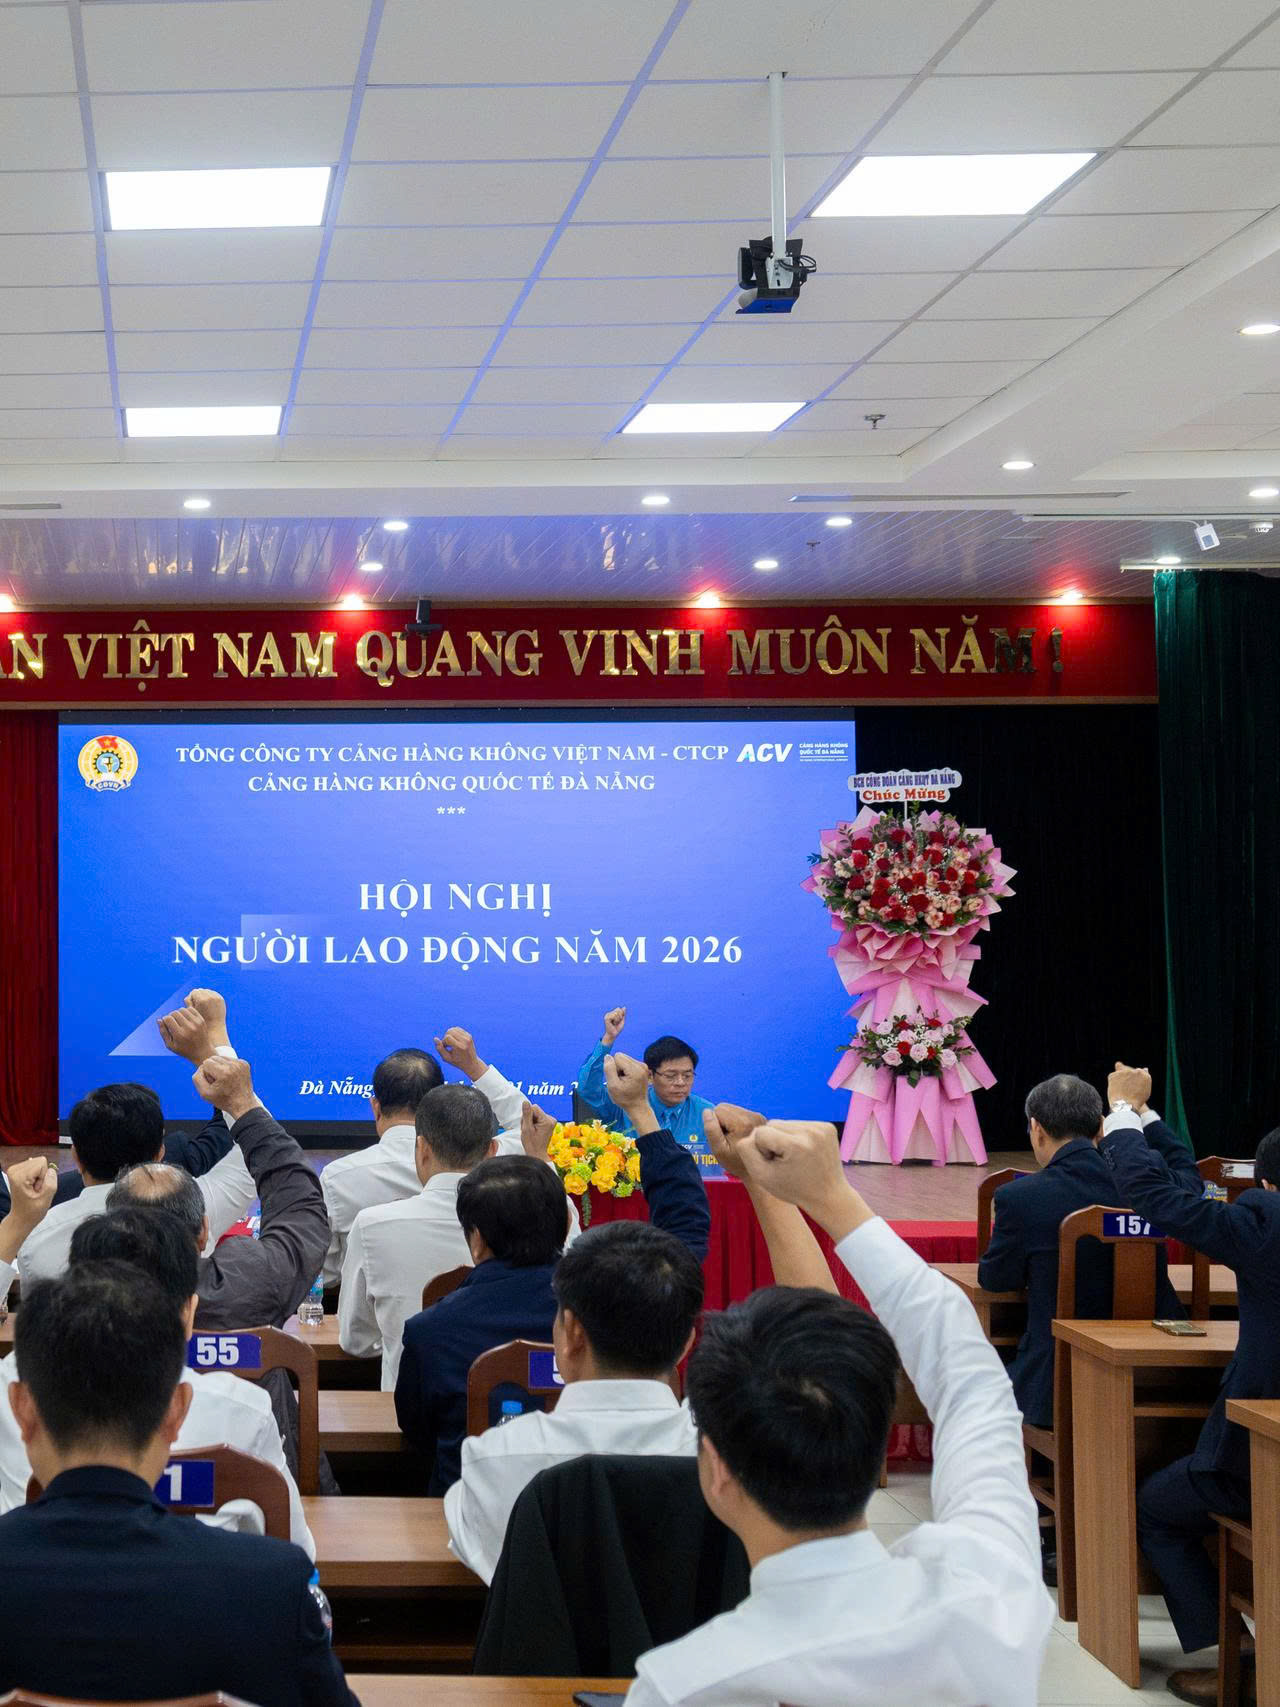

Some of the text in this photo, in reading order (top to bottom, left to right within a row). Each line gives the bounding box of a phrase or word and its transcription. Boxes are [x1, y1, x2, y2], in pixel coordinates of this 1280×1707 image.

[63, 619, 195, 692] VIỆT
[213, 631, 338, 678] NAM
[355, 628, 544, 688] QUANG
[558, 629, 705, 676] VINH
[726, 614, 892, 675] MUÔN
[909, 614, 1037, 675] NĂM
[176, 743, 235, 762] TỔNG
[240, 743, 300, 762] CÔNG
[305, 747, 334, 762] TY
[338, 743, 397, 762] CẢNG
[403, 743, 463, 762] HÀNG
[471, 742, 547, 761] KHÔNG
[552, 743, 602, 764] VIỆT
[607, 746, 655, 761] NAM
[672, 745, 729, 761] CTCP
[736, 743, 793, 762] ACV
[248, 771, 655, 794] CẢNG HÀNG KHÔNG QUỐC TẾ ĐÀ NẴNG
[863, 788, 946, 800] Chúc Mừng
[359, 878, 553, 918] HỘI NGHỊ
[171, 928, 743, 971] NGƯỜI LAO ĐỘNG NĂM 2026
[299, 1080, 325, 1095] Đà
[528, 1081, 565, 1095] năm
[196, 1336, 240, 1366] 55
